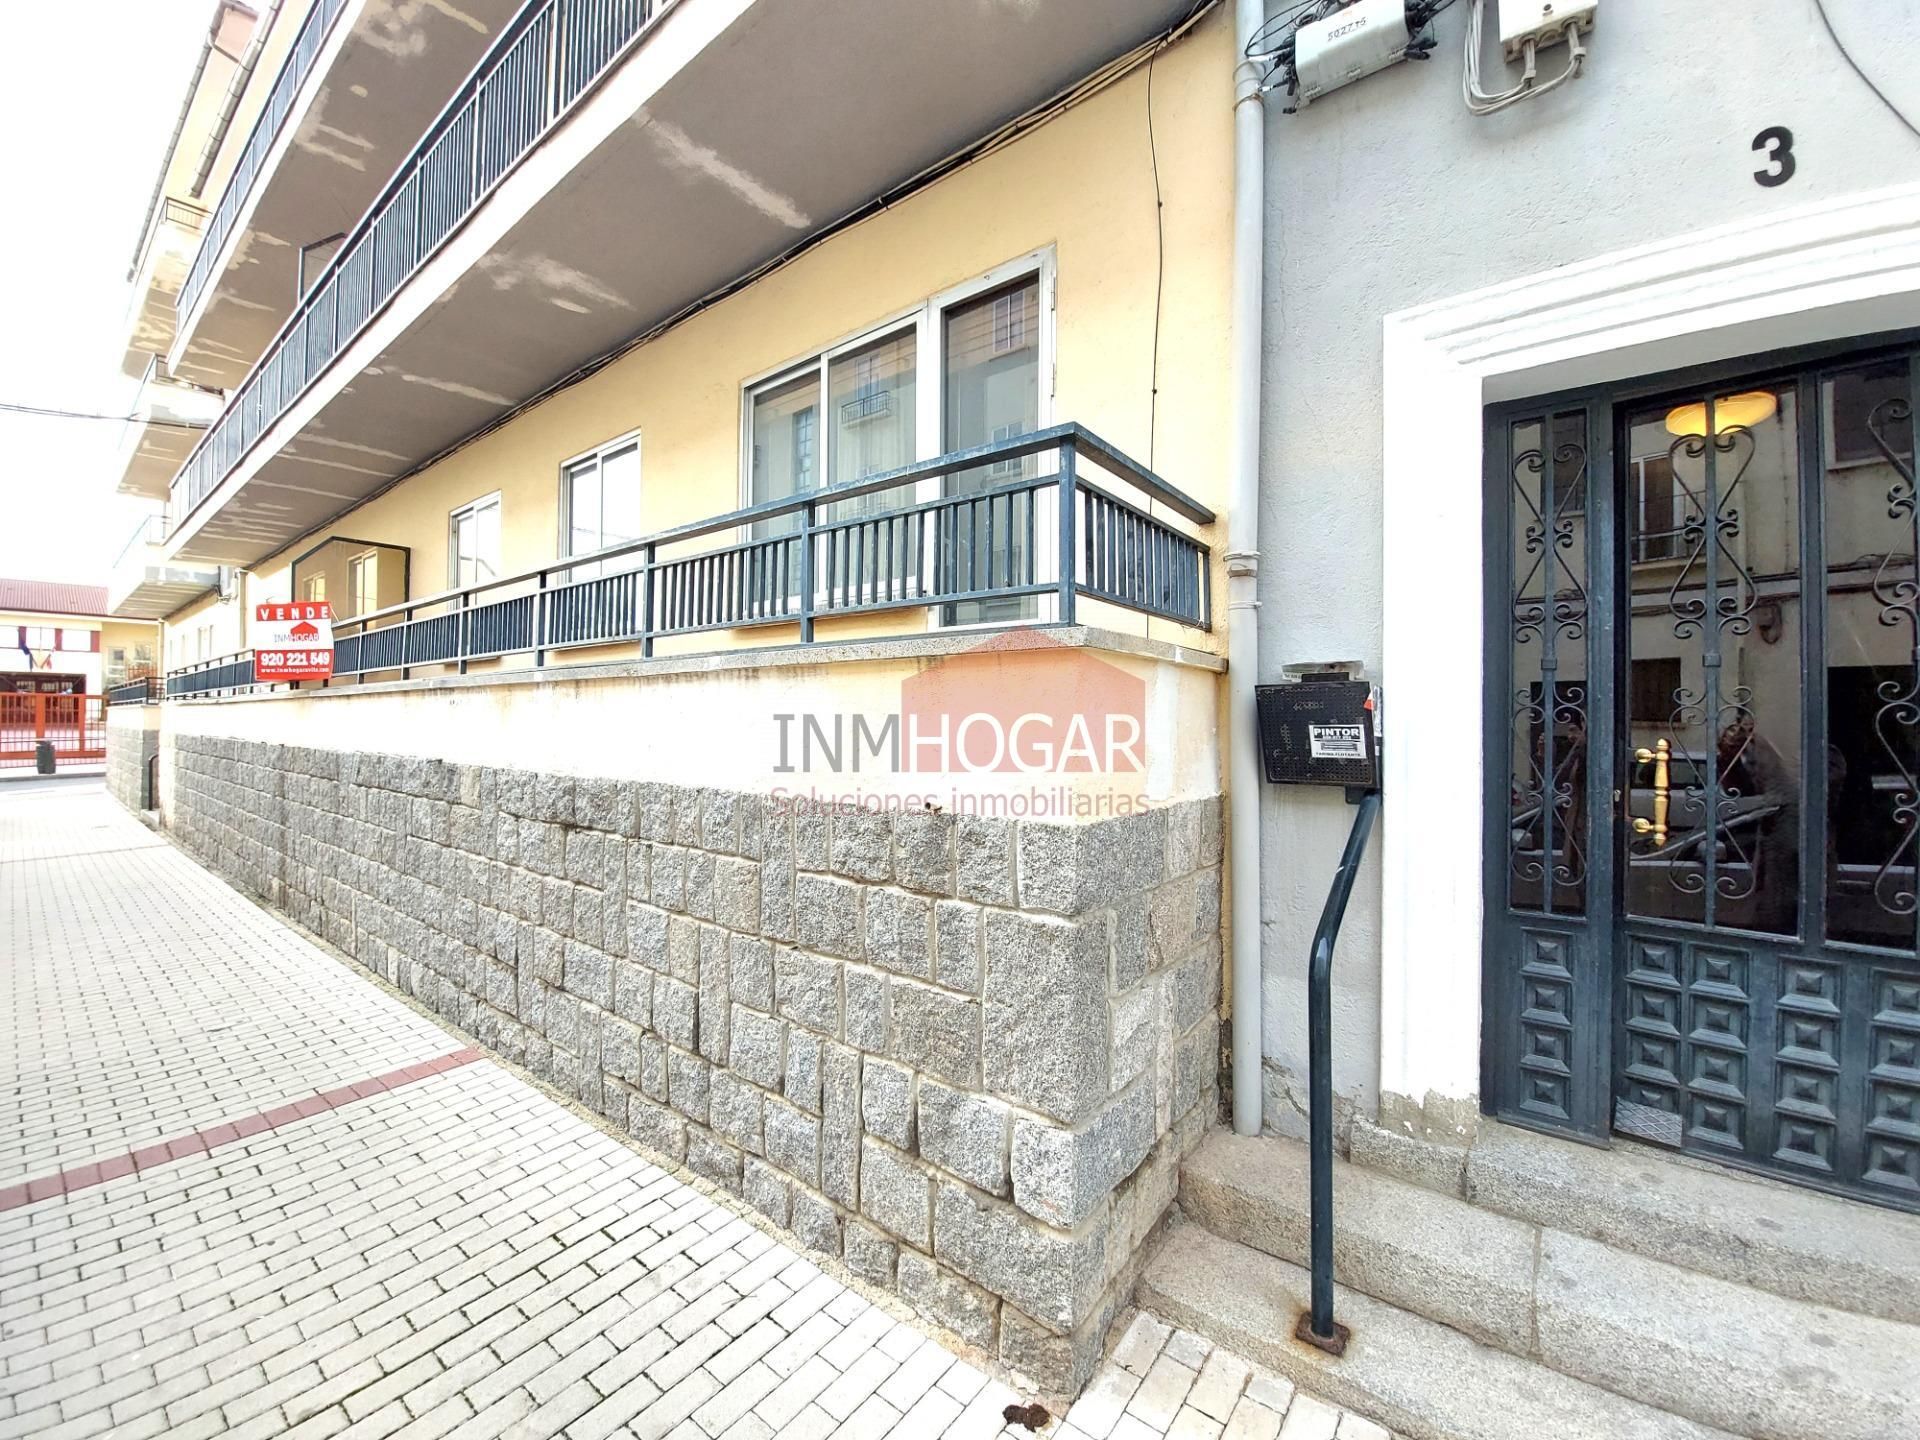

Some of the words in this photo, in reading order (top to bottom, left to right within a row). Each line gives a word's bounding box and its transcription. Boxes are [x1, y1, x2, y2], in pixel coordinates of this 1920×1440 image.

[1752, 125, 1796, 188] 3
[260, 606, 328, 620] VENDE
[273, 633, 319, 642] INMHOGAR
[261, 652, 284, 666] 920
[286, 652, 309, 666] 221
[1314, 728, 1359, 736] PINTOR
